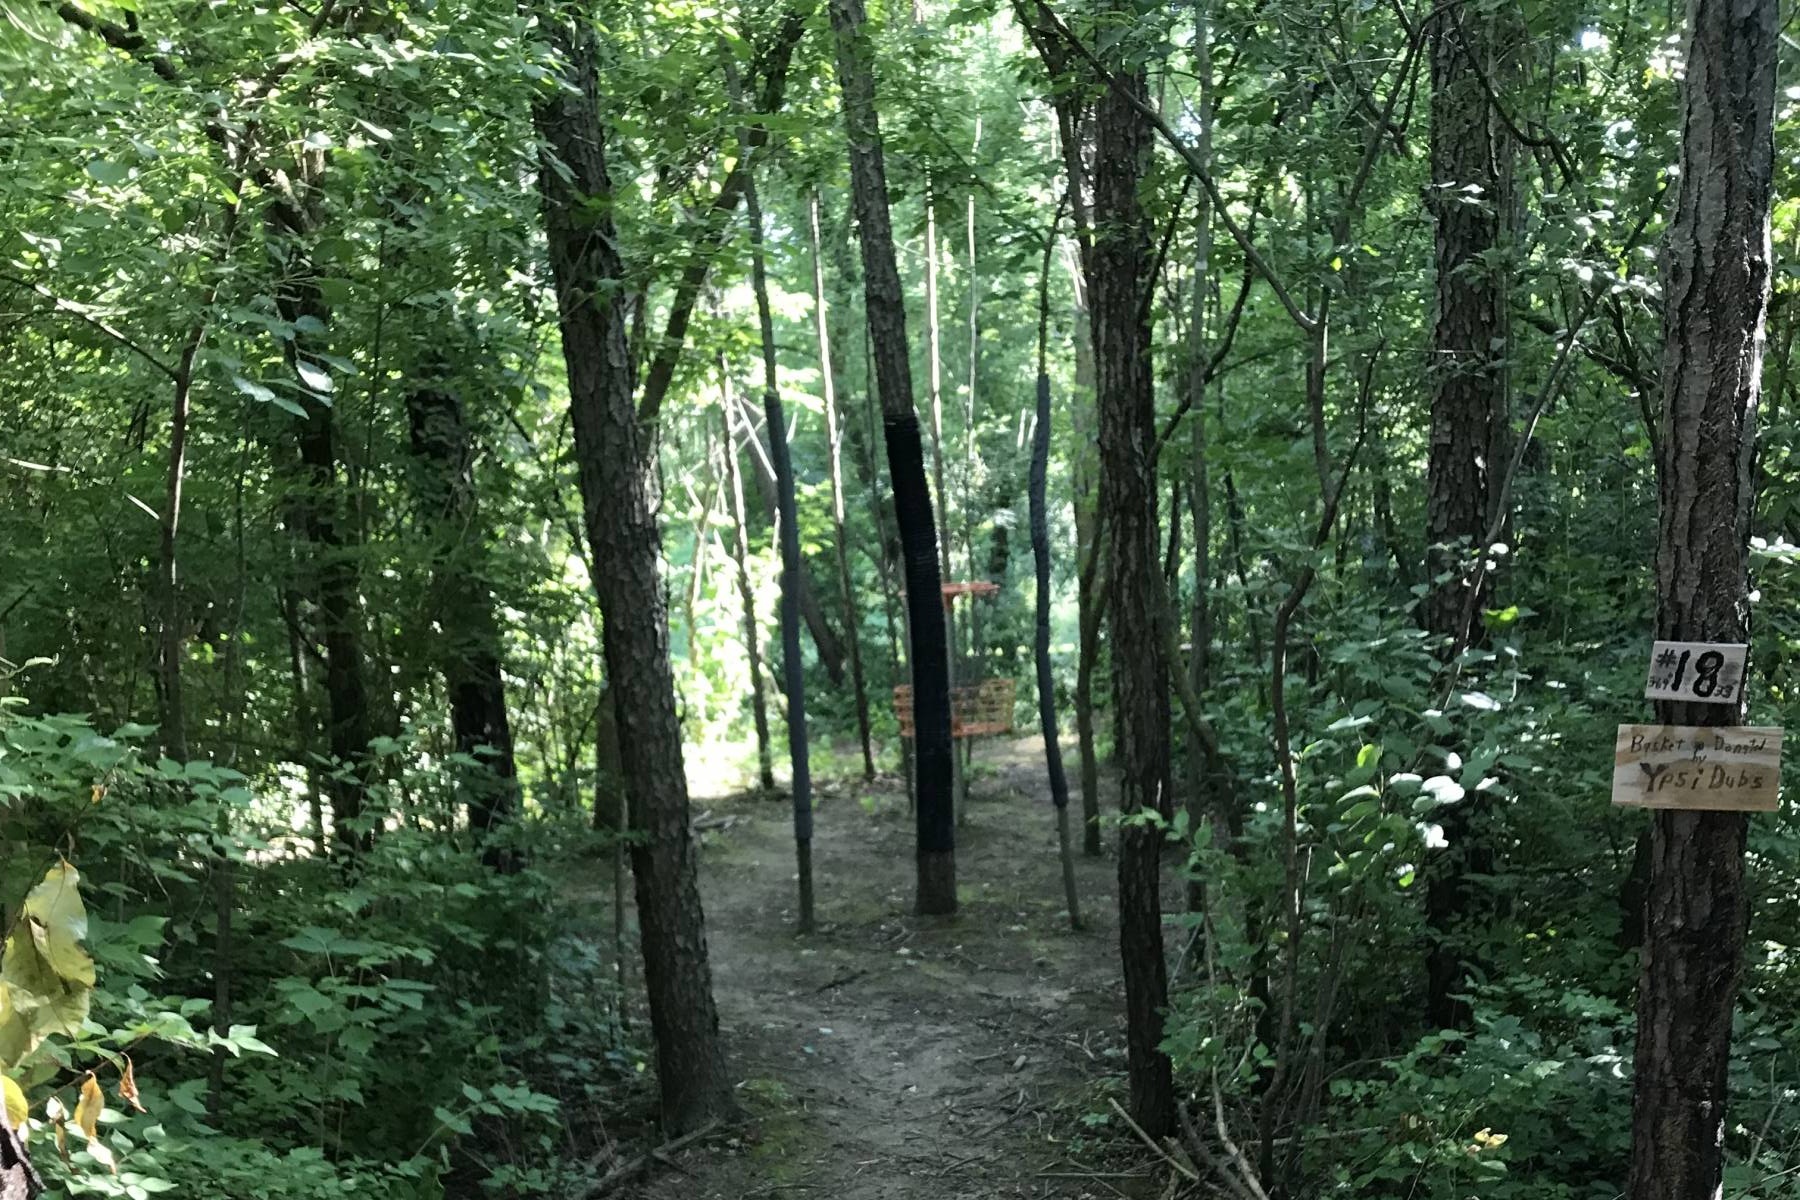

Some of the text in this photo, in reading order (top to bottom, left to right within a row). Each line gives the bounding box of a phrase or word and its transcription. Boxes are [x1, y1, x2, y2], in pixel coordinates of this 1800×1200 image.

[1630, 735, 1686, 753] Basket
[1639, 762, 1764, 793] Ypsi Dubs
